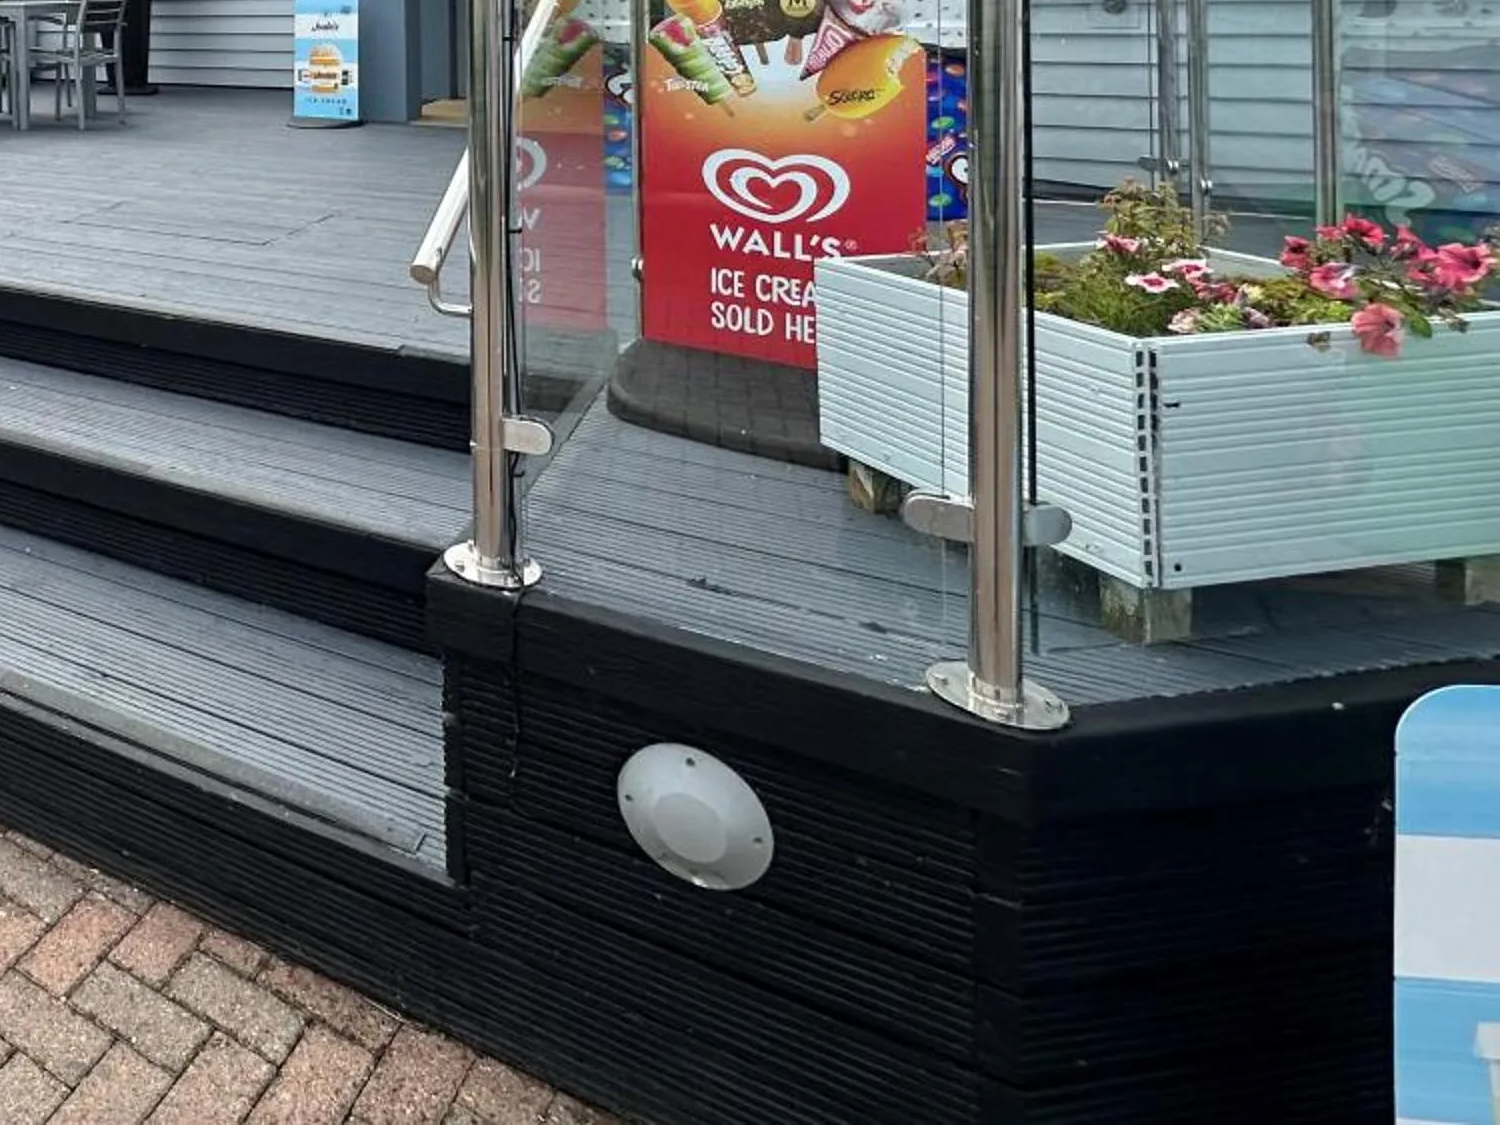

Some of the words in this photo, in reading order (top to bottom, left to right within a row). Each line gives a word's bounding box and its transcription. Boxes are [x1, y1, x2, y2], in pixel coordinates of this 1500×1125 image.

[709, 223, 842, 261] WALL'S
[710, 267, 745, 298] ICE
[755, 274, 816, 308] CREA
[711, 301, 774, 336] SOLD
[785, 312, 815, 344] HE
